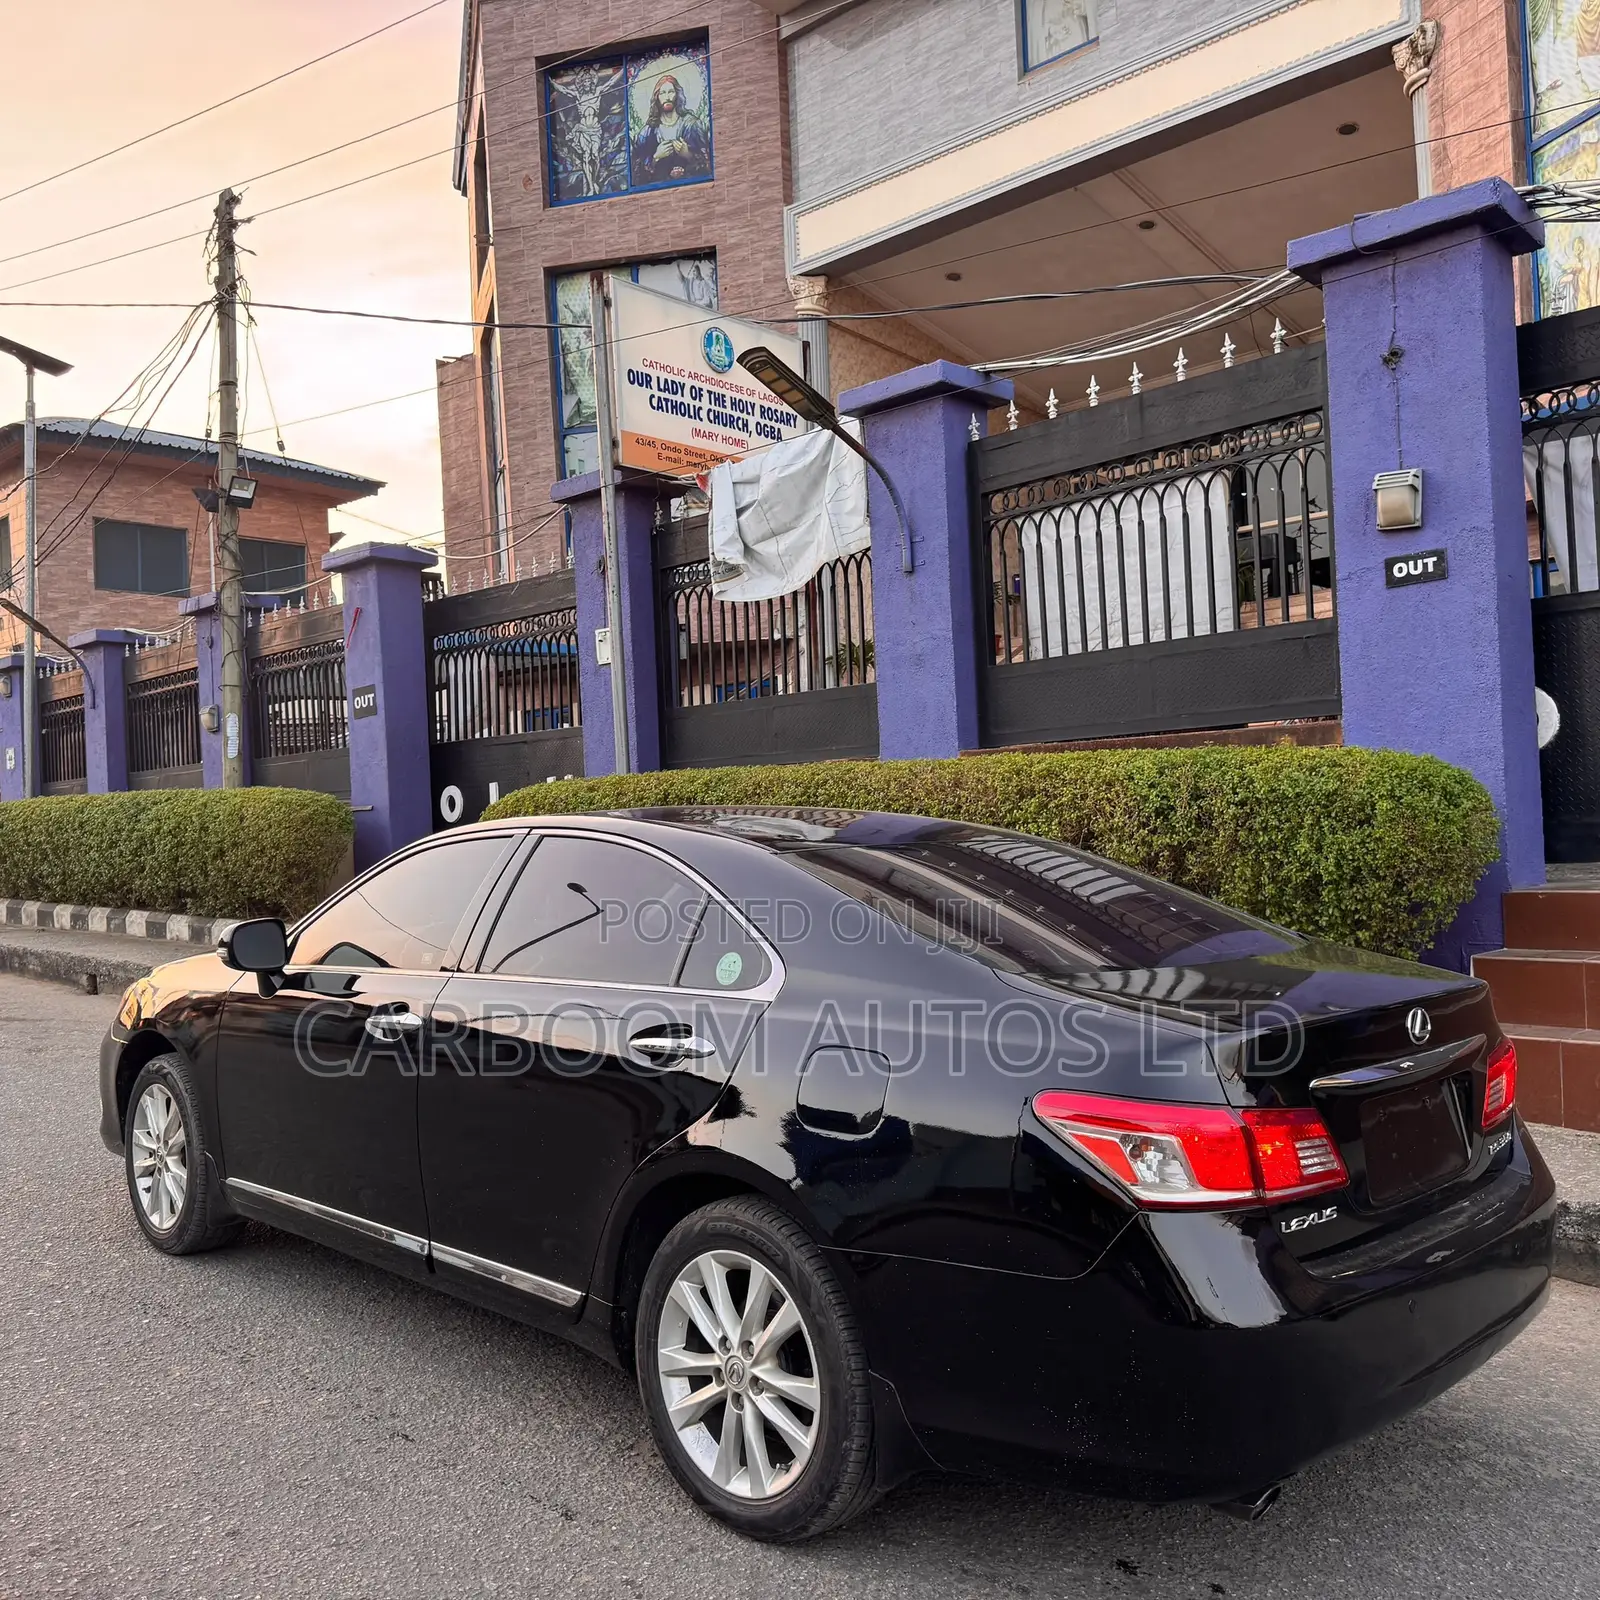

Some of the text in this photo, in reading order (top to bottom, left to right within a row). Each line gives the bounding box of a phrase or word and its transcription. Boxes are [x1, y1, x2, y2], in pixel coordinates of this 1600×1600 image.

[642, 358, 784, 406] CATHOLIC ARCHDIOCESE OF LAGOS
[627, 368, 798, 429] OUR LADY OF THE HOLY ROSARY
[648, 393, 783, 442] CATHOLIC CHURCH, OGBA
[635, 437, 658, 450] 43/45,
[660, 442, 682, 455] Ondo
[683, 447, 708, 462] Street,
[691, 427, 749, 450] (MARY HOME)
[657, 452, 684, 465] E-mail:
[1392, 556, 1438, 578] OUT
[354, 693, 375, 709] OUT
[1280, 1206, 1338, 1233] LEXUS
